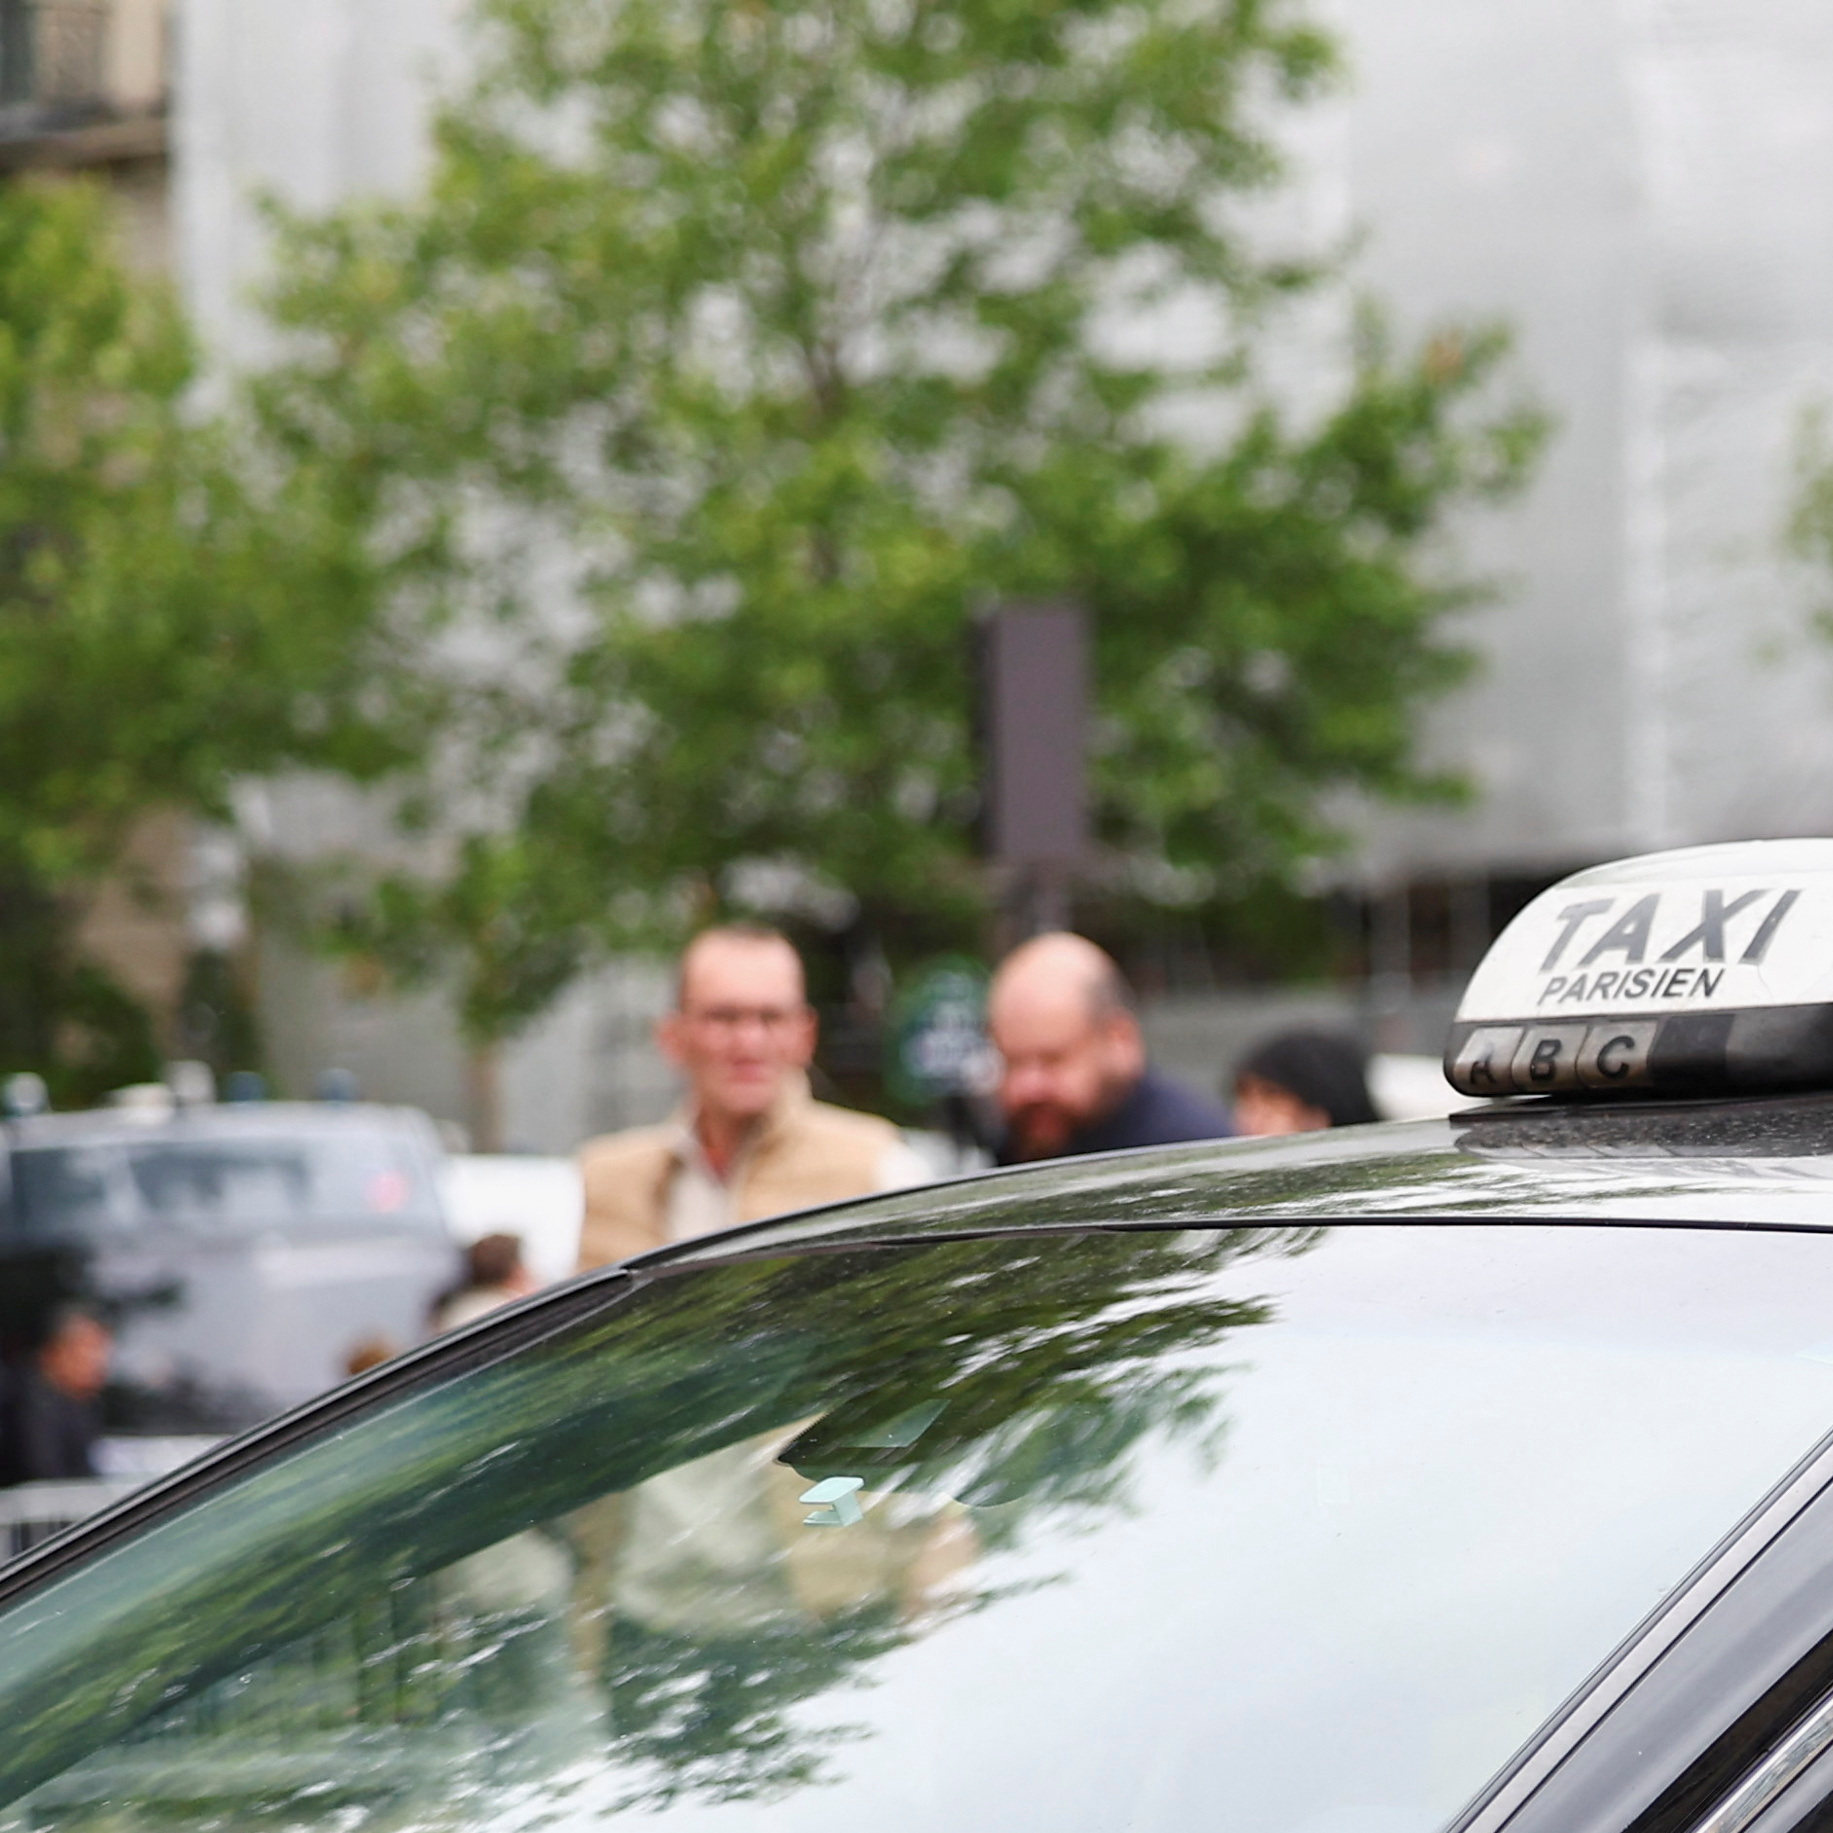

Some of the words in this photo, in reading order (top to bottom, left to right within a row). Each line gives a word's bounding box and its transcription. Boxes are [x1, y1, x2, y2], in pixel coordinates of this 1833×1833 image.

[1537, 888, 1804, 974] TAXI
[1537, 966, 1726, 1007] PARISIEN
[1530, 1039, 1562, 1081] B
[1596, 1034, 1636, 1079] C
